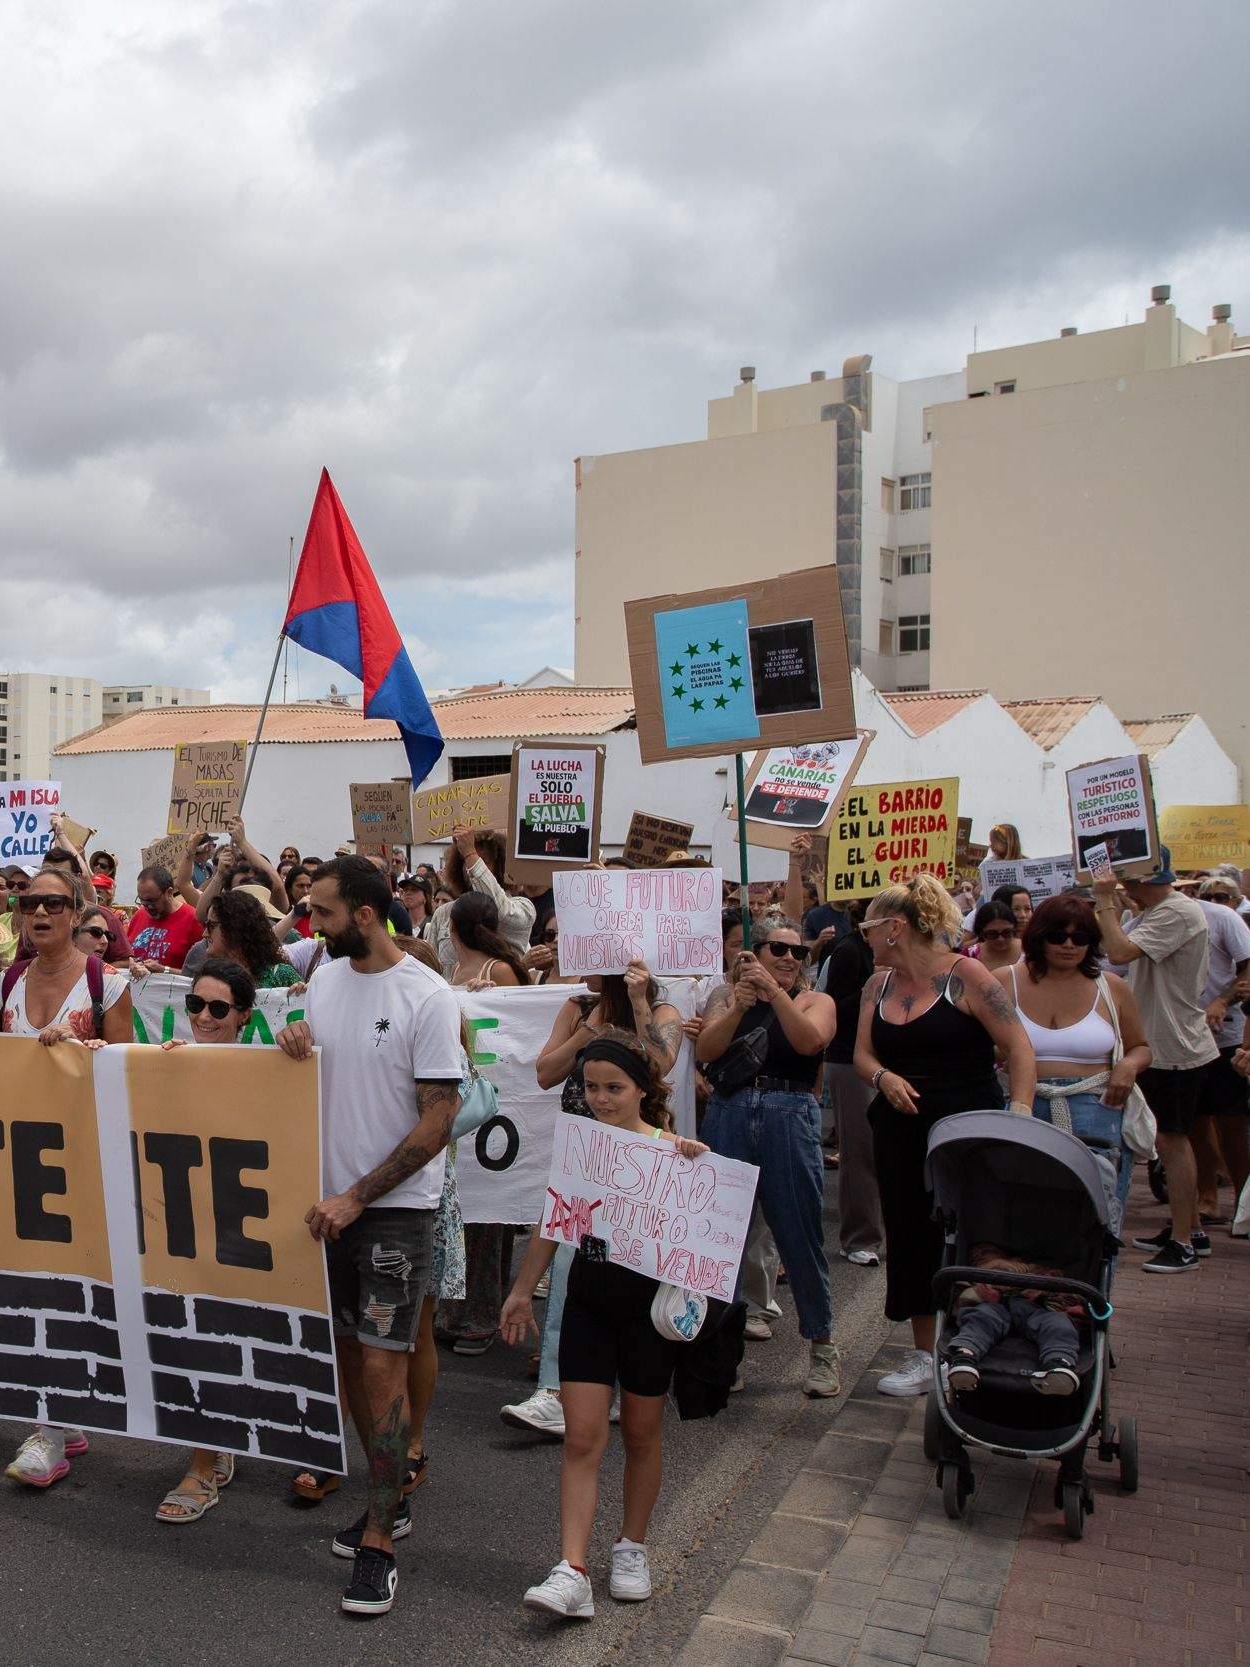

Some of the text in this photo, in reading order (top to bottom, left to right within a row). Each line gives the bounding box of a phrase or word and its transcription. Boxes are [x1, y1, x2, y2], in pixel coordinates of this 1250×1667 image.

[690, 667, 722, 676] PISCINAS
[703, 680, 724, 688] PAPAS
[179, 747, 193, 763] EL
[232, 743, 243, 761] DE
[195, 763, 235, 780] MASAS
[531, 760, 583, 772] LA LUCHA
[769, 764, 837, 784] CANARIAS
[1110, 768, 1135, 778] MODELO
[536, 772, 578, 781] ES NUESTRA
[774, 776, 785, 784] no
[797, 780, 822, 789] vende
[227, 782, 240, 798] EN
[364, 790, 393, 802] SEQUEN
[415, 781, 501, 810] CANARIAS
[540, 780, 573, 794] SOLO
[763, 782, 825, 799] SE DEFIENDE
[1082, 777, 1137, 798] TURÍSTICO
[9, 789, 26, 808] MI
[30, 788, 60, 806] ISLA
[529, 793, 583, 805] EL PUEBLO
[848, 784, 943, 818] EL BARRIO
[1077, 790, 1139, 811] RESPETUOSO
[429, 806, 454, 821] NO
[531, 805, 581, 823] SALVA
[1077, 801, 1140, 821] CON LAS PERSONAS
[1080, 809, 1141, 829] Y EL ENTORNO
[11, 811, 38, 833] YO
[532, 823, 577, 833] AL PUEBLO
[839, 821, 861, 840] EN
[868, 820, 885, 838] LA
[891, 814, 948, 837] MIERDA
[847, 838, 928, 865] EL GUIRI
[834, 872, 855, 890] EN
[861, 870, 881, 888] LA
[625, 871, 715, 911] FUTURO
[594, 909, 691, 935] QUEDA PARA
[563, 932, 644, 970] NUESTROS
[563, 1123, 717, 1214] NUESTRO
[601, 1193, 689, 1244] FUTURO
[609, 1228, 735, 1297] SE VENDE
